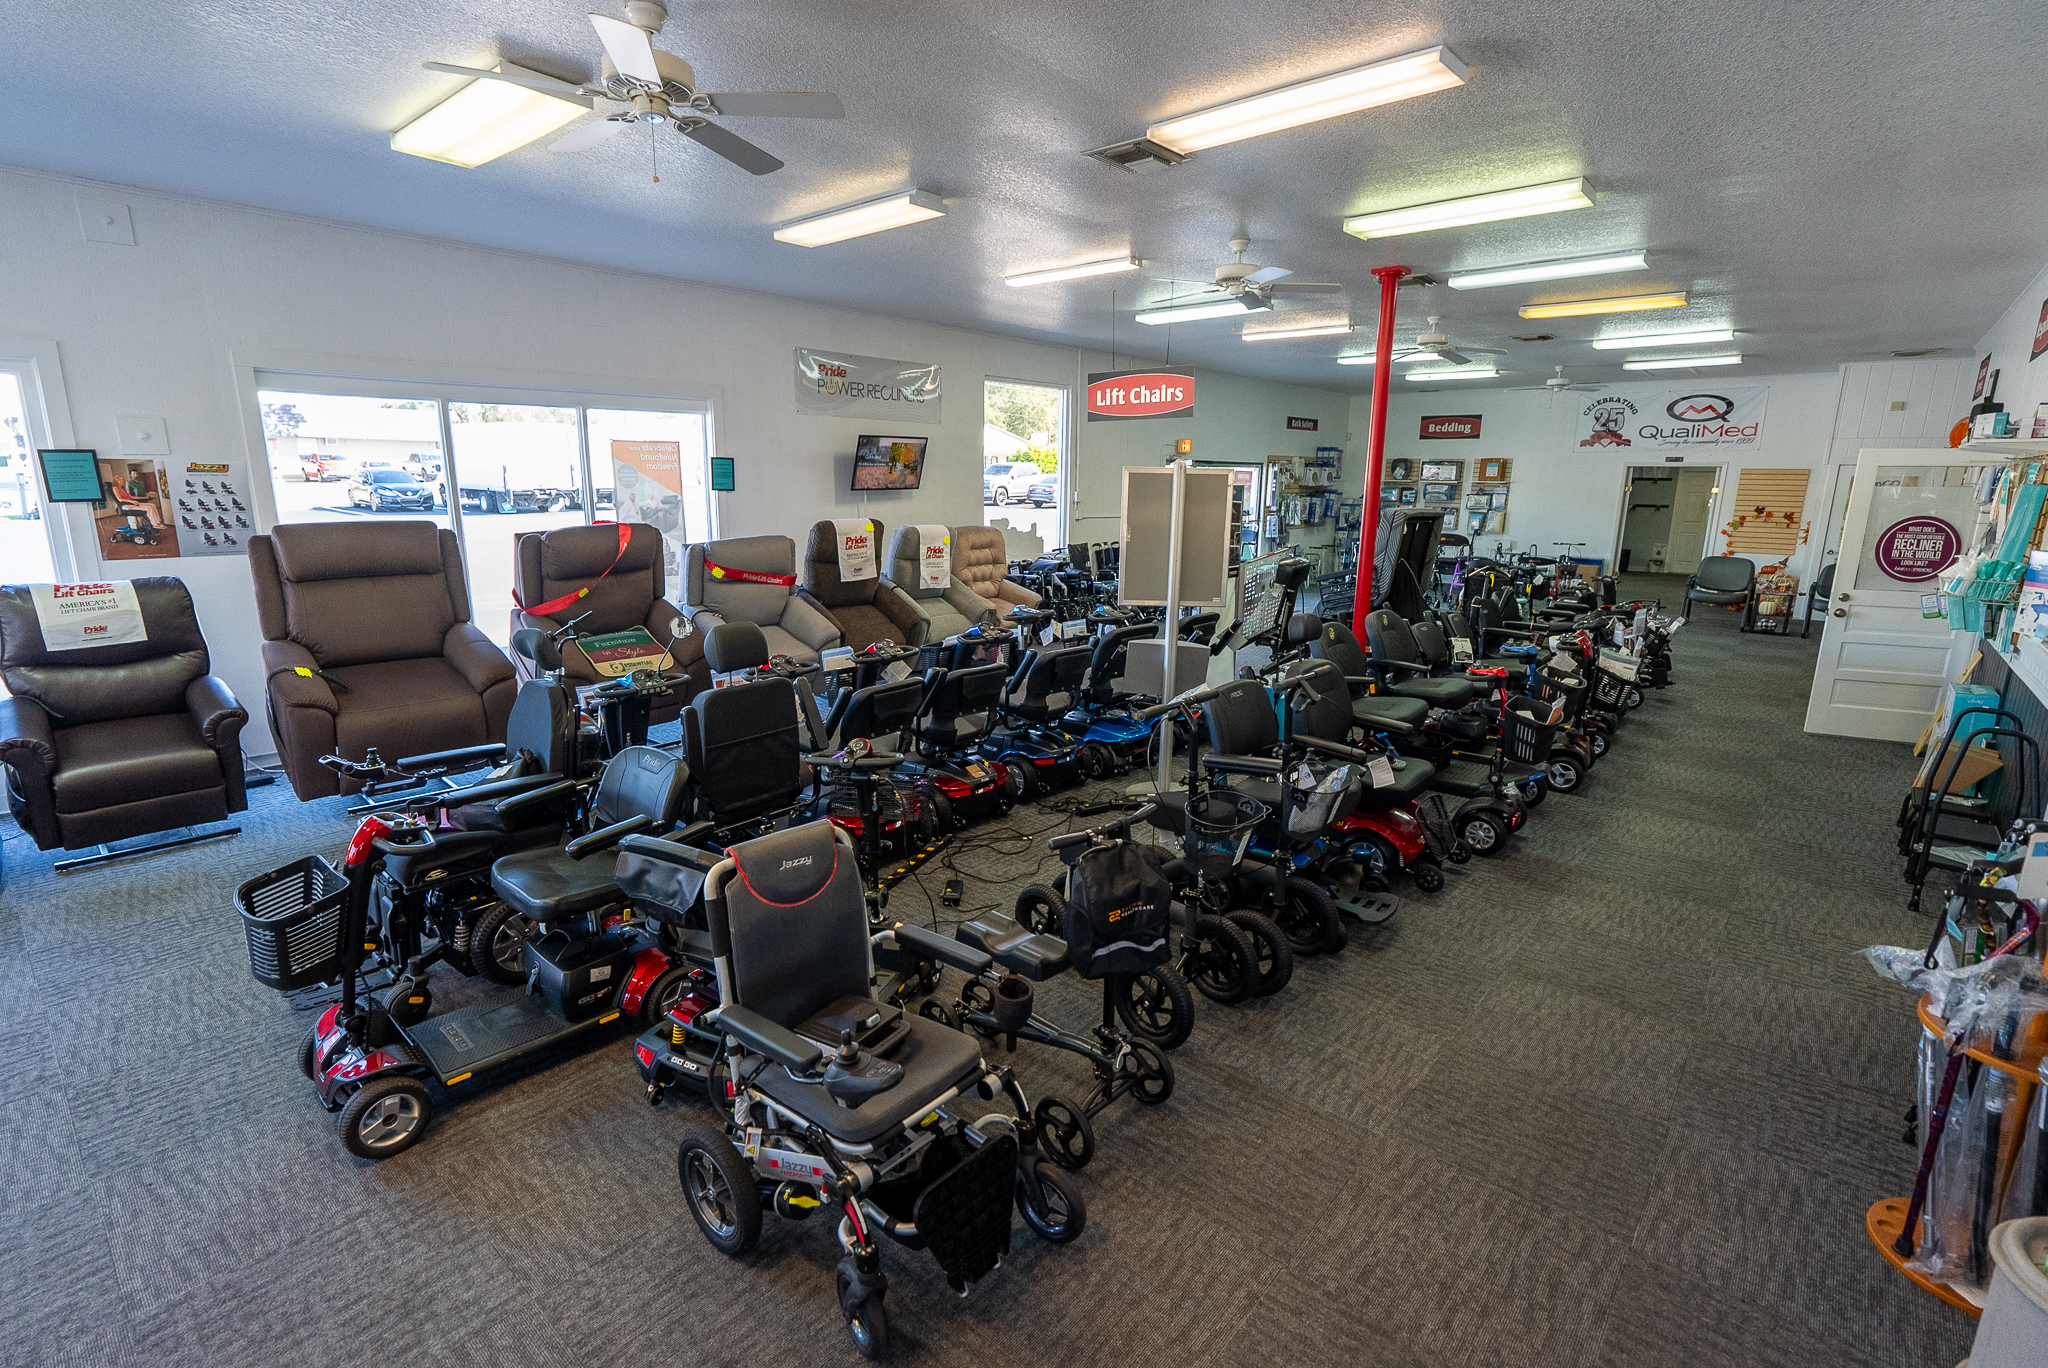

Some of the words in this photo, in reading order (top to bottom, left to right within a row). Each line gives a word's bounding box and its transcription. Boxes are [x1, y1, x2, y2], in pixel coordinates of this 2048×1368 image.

[818, 363, 847, 378] Pride
[867, 384, 925, 404] RECLINERS
[1096, 387, 1126, 407] Lift
[1129, 384, 1184, 405] Chairs
[1583, 396, 1639, 416] CELEBRATING
[1592, 407, 1626, 433] 25
[1428, 422, 1472, 434] Bedding
[1638, 422, 1759, 441] QualiMed
[1690, 438, 1720, 447] community
[1735, 437, 1756, 445] 1999
[187, 462, 229, 473] Jazzy
[845, 535, 868, 546] Pride
[1893, 538, 1944, 551] RECLINER
[926, 546, 944, 555] Pride
[1891, 549, 1900, 558] IN
[1900, 550, 1915, 558] THE
[1915, 550, 1942, 559] WORLD
[53, 590, 75, 599] Lift
[77, 587, 115, 597] Chairs
[59, 599, 107, 610] AMERICA'S
[97, 604, 119, 612] BRAND
[83, 625, 107, 634] Pride
[594, 638, 637, 648] Furniture
[614, 647, 646, 658] Style
[624, 660, 654, 668] ESSENTIAL
[642, 754, 661, 768] Pride
[780, 855, 813, 870] Jazzy
[780, 1157, 813, 1178] Jazzy
